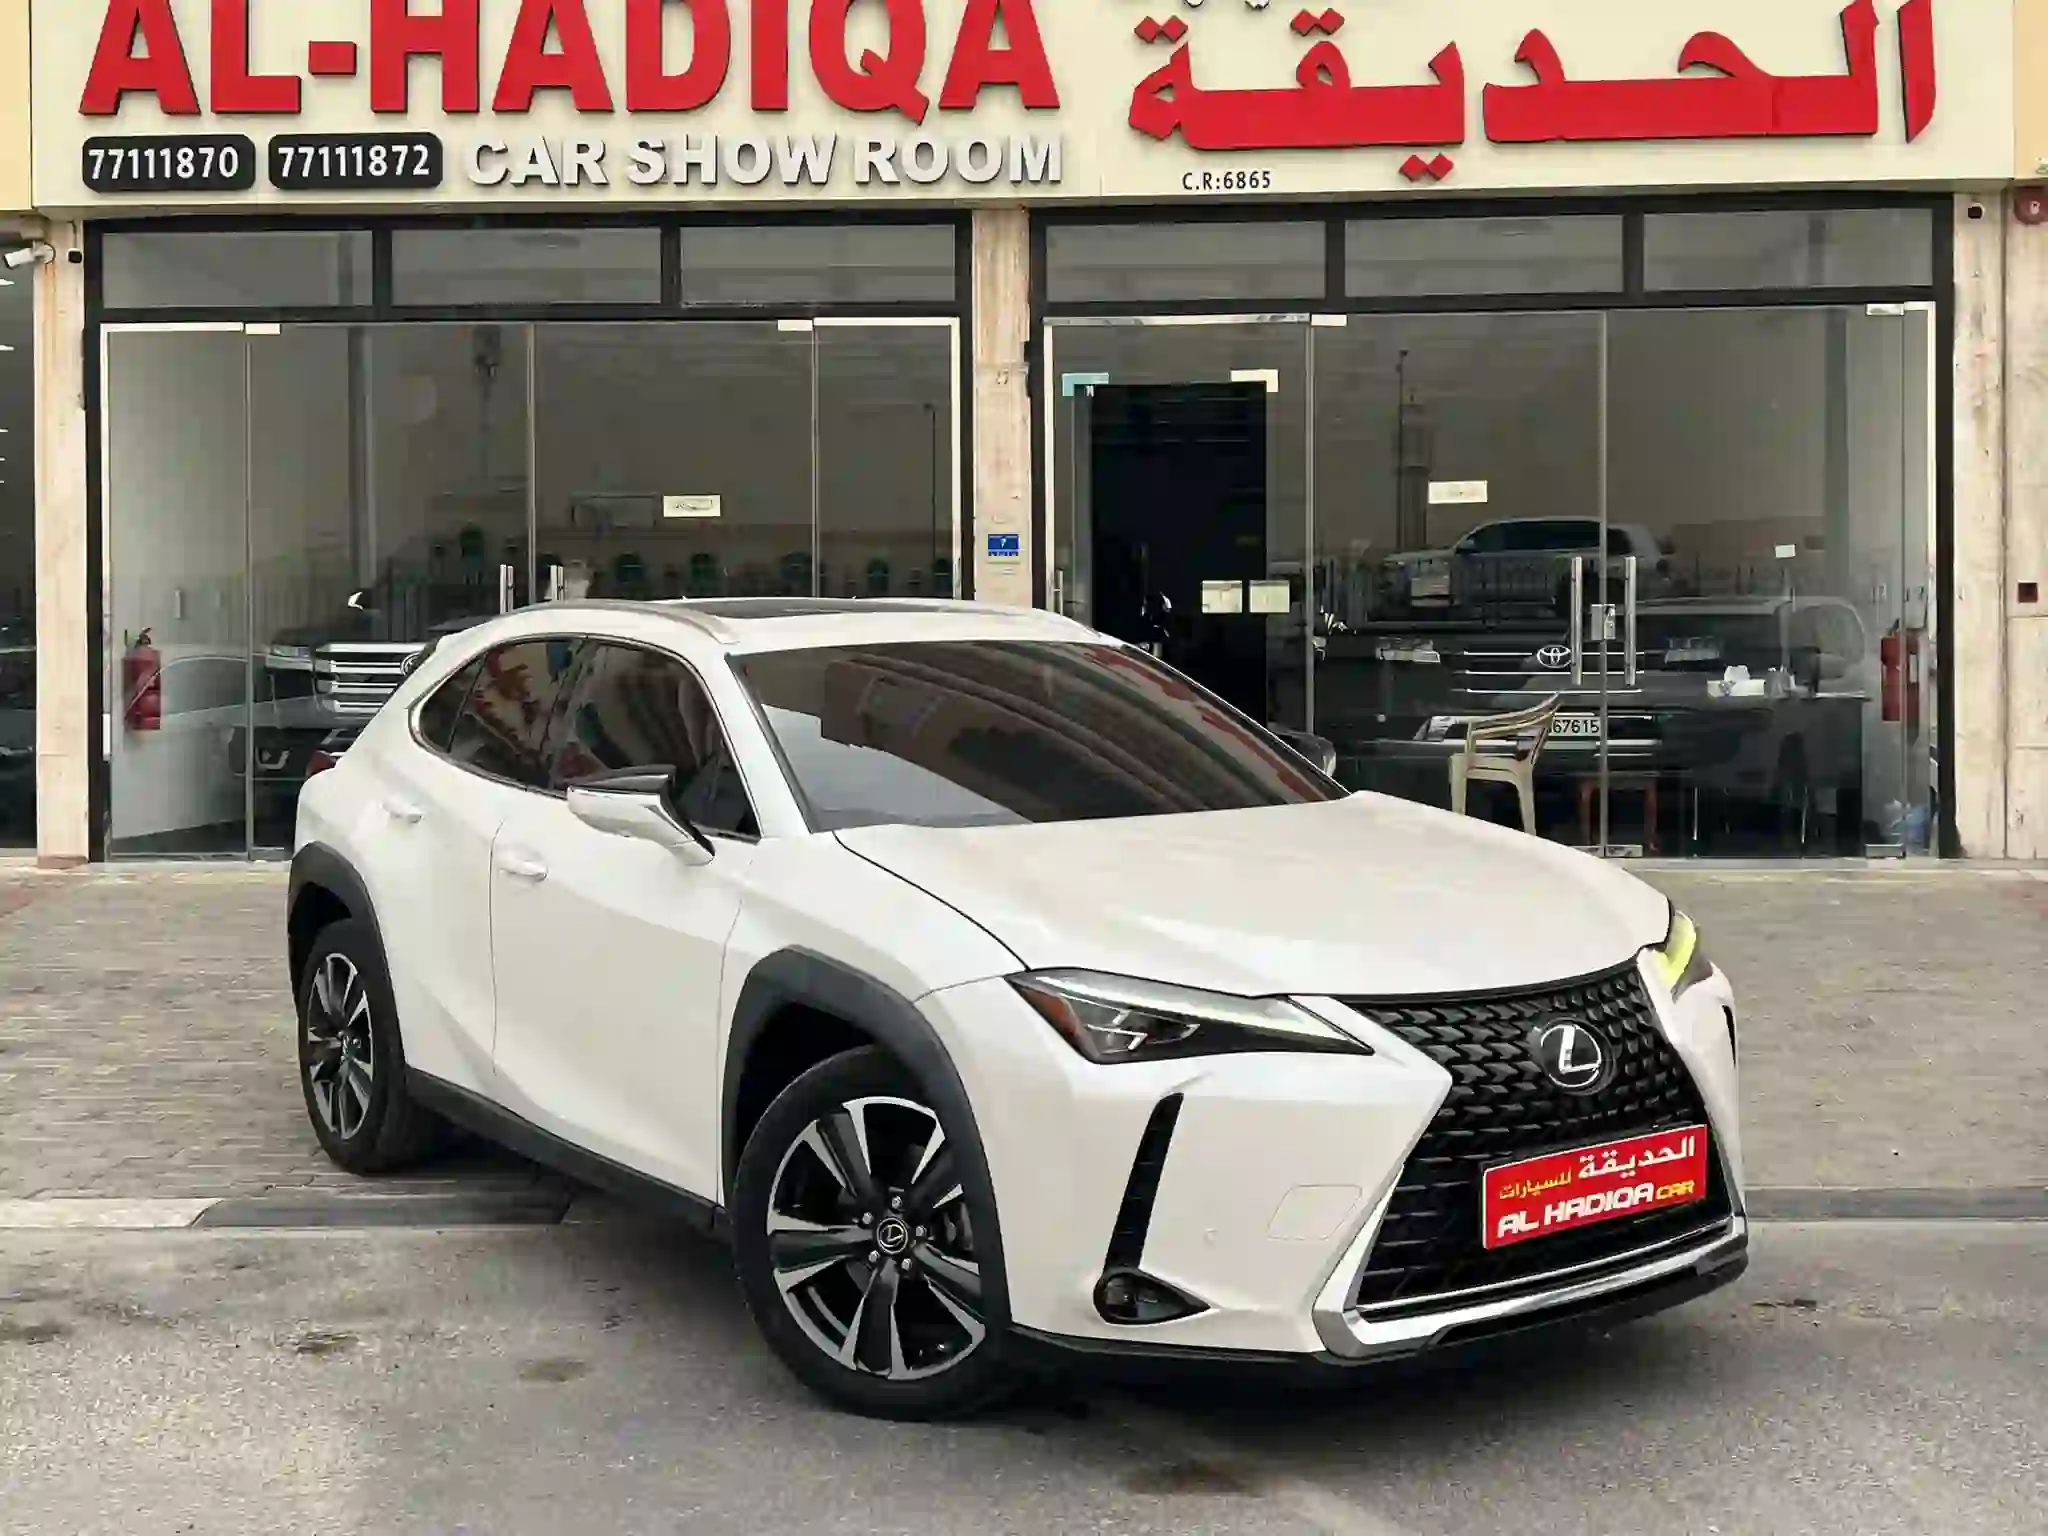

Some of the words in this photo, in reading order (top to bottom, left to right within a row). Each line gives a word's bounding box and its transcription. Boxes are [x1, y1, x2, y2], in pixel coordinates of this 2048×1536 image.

[80, 0, 1060, 124] AL-HADIQA
[1128, 0, 1937, 179] الحديقة
[88, 146, 239, 180] 77111870
[278, 143, 430, 178] 77111872
[467, 135, 609, 187] CAR
[627, 132, 836, 186] SHOW
[853, 134, 1062, 184] ROOM
[1182, 170, 1272, 191] C.R:6865
[1549, 719, 1600, 734] 67615
[1578, 1135, 1695, 1180] الحديقة
[1497, 1210, 1540, 1238] AL
[1655, 1180, 1695, 1200] CAR
